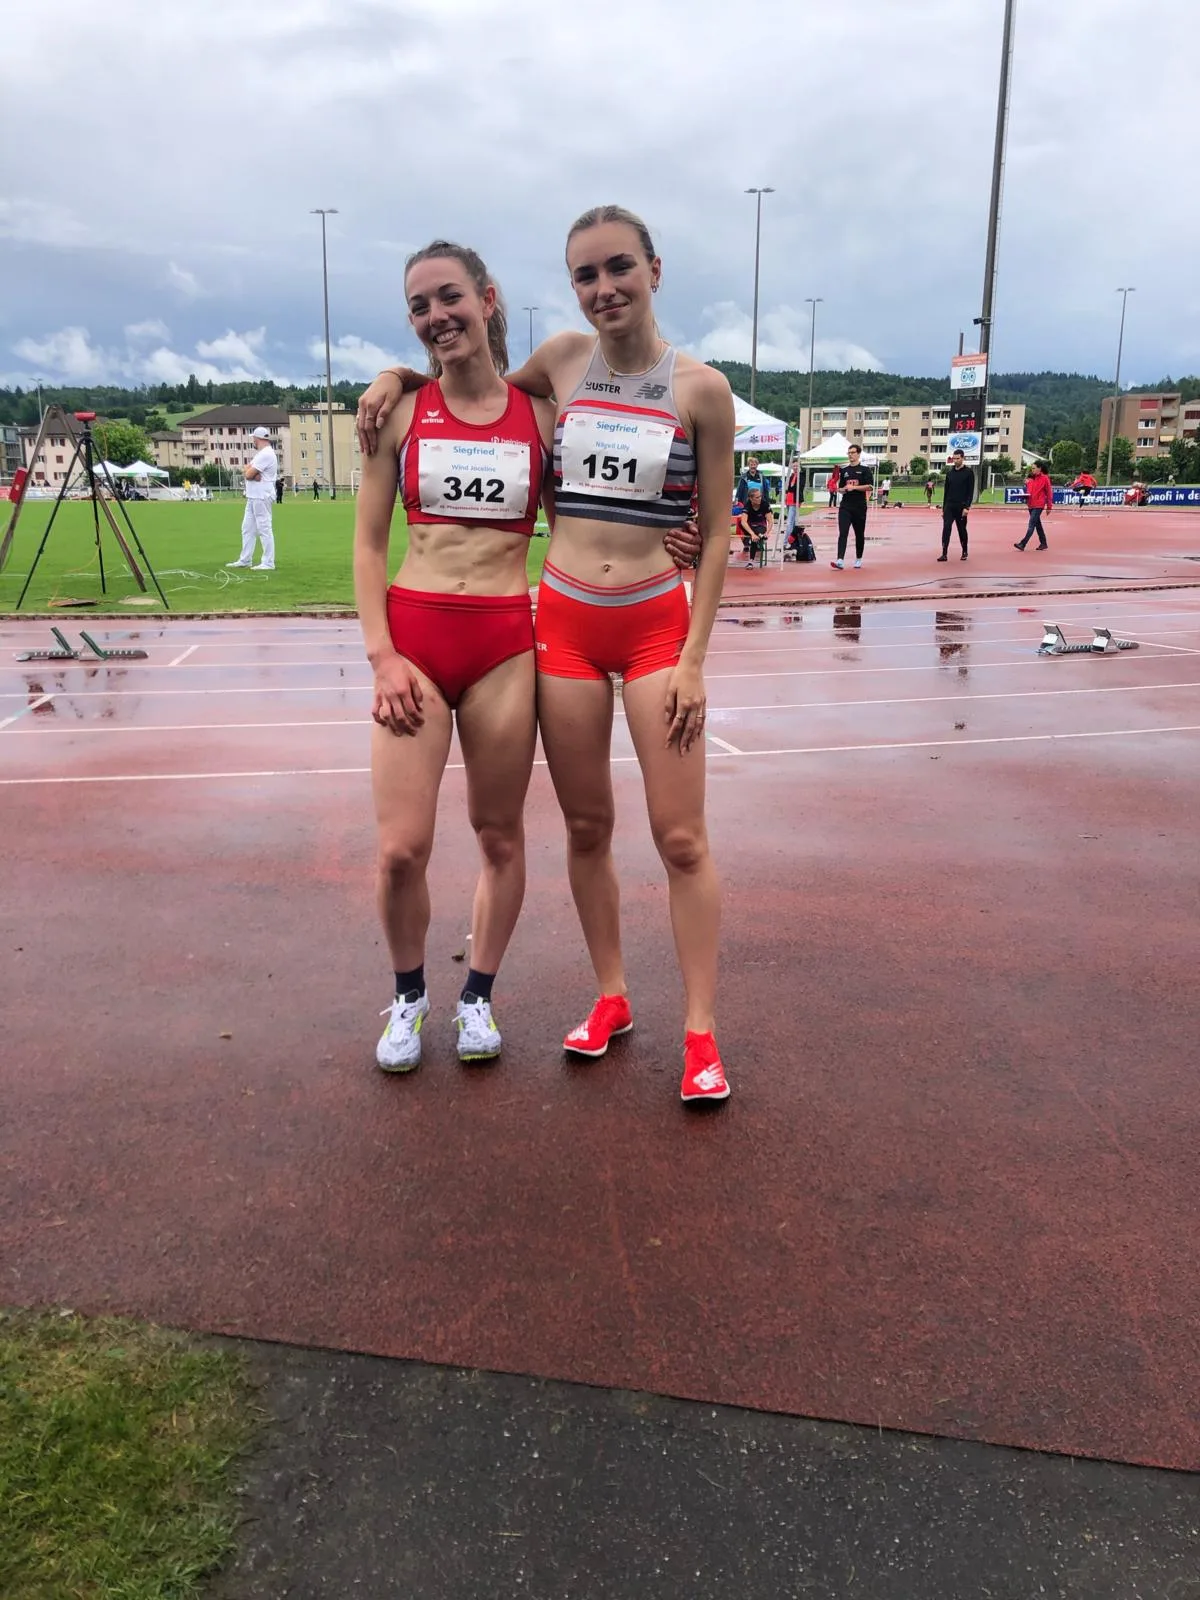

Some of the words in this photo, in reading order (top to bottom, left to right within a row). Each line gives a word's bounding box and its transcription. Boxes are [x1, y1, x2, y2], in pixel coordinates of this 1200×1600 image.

[592, 383, 620, 394] USTER
[596, 421, 638, 434] Siegfried
[760, 435, 780, 443] UBS
[954, 438, 974, 447] Ford
[453, 446, 495, 456] Siegfried
[583, 454, 637, 483] 151
[443, 476, 505, 504] 342
